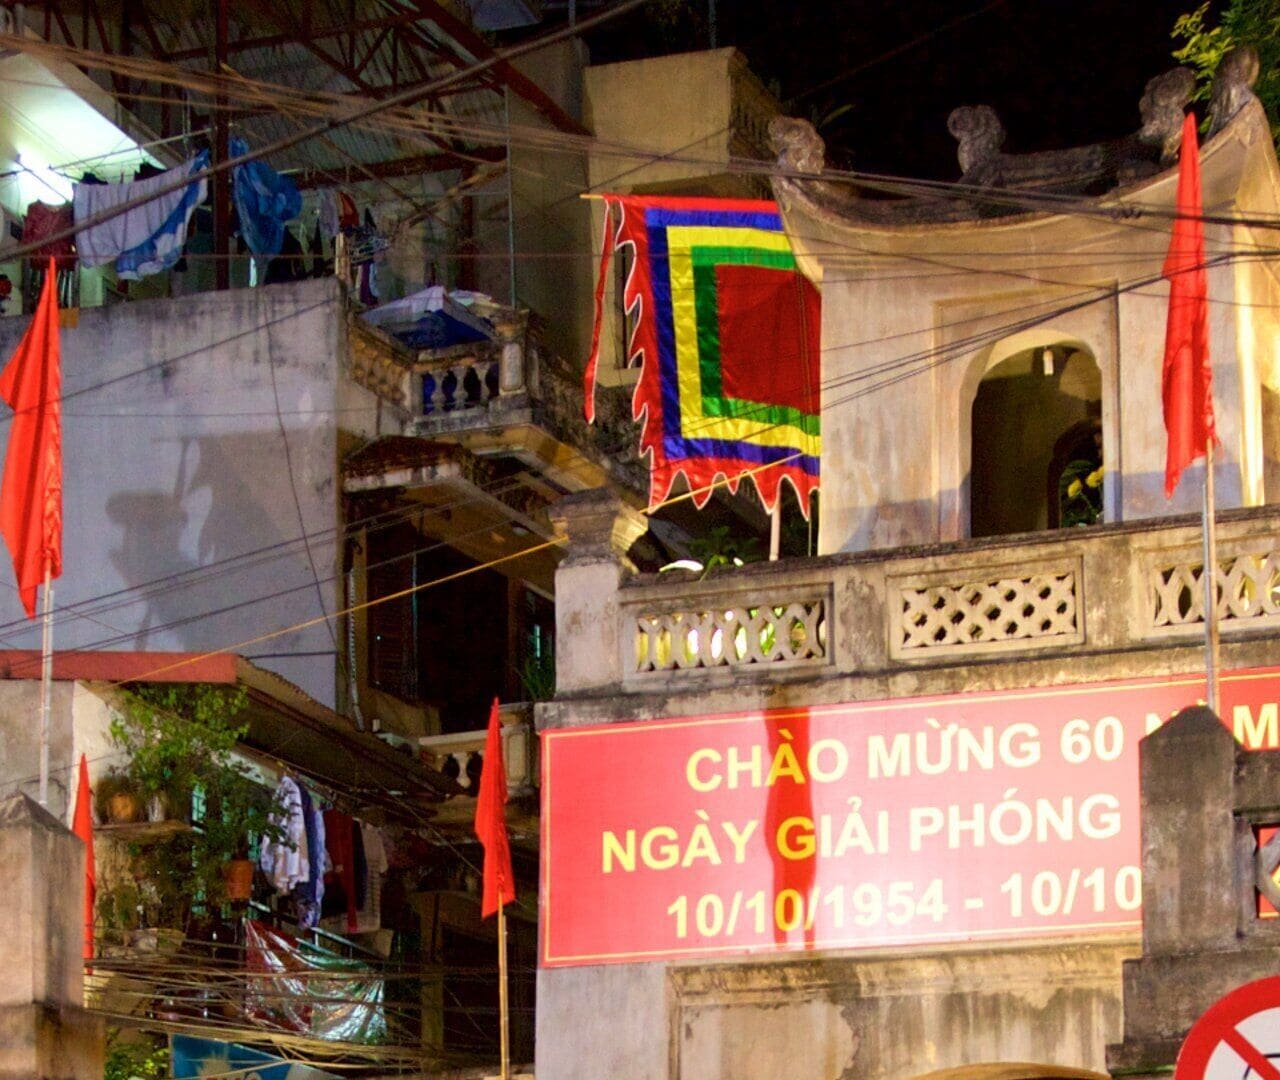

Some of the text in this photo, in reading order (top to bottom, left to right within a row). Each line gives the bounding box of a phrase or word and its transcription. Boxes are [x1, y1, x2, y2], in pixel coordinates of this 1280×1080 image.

[686, 728, 850, 792] CHÀO
[867, 717, 1042, 780] MỪNG
[1060, 716, 1125, 765] 60
[601, 787, 1122, 874] NGÀY GIẢI PHÓNG
[667, 878, 949, 939] 10/10/1954
